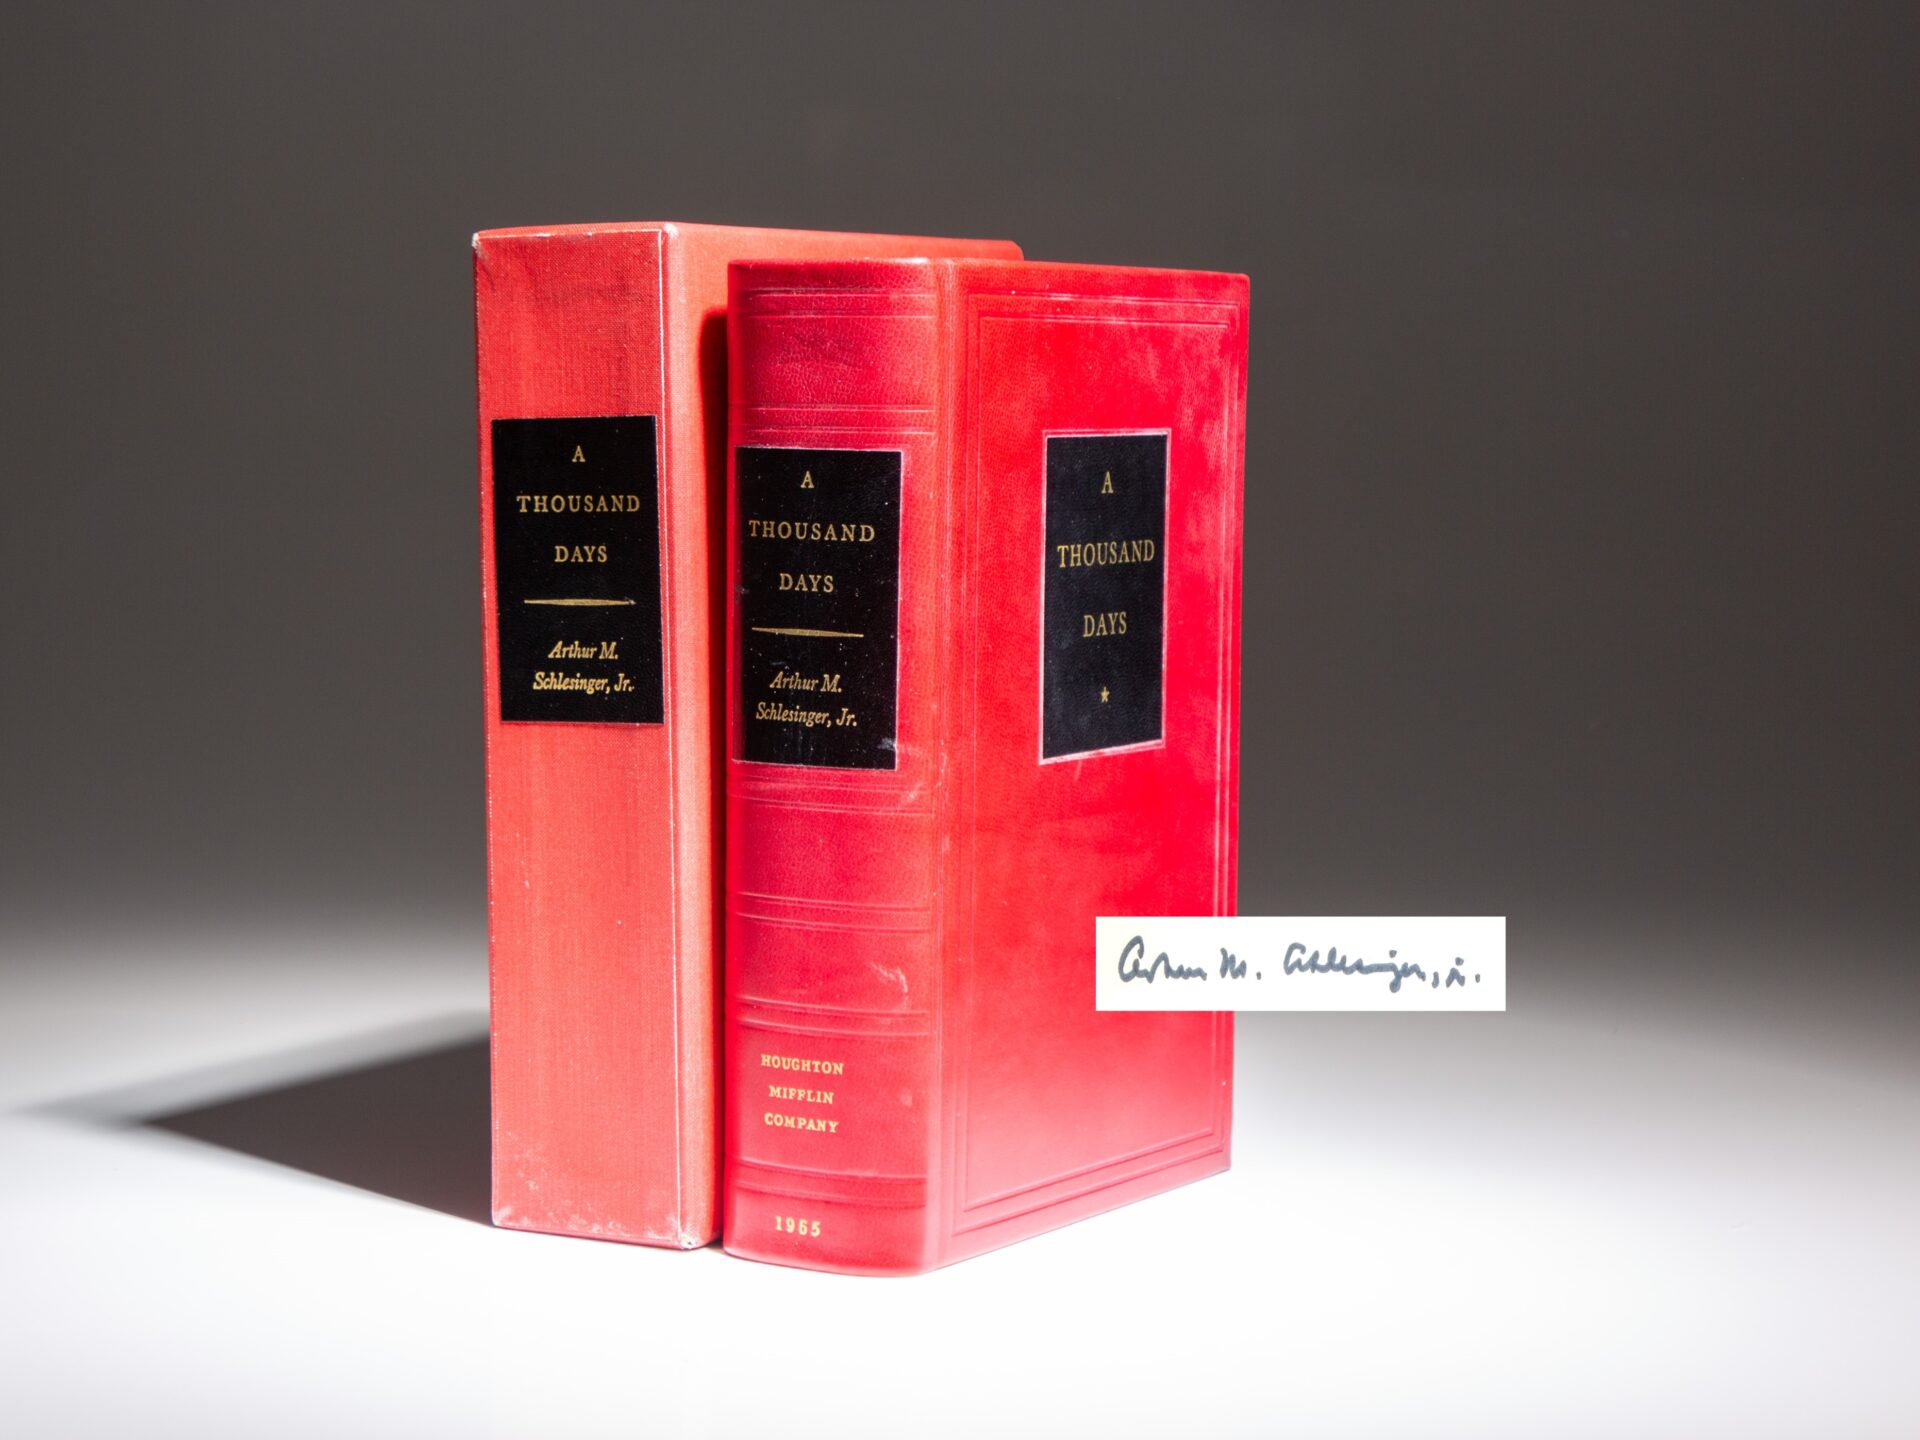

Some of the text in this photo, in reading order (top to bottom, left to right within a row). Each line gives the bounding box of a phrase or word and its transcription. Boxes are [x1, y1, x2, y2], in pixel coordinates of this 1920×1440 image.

[572, 445, 586, 463] A
[800, 470, 815, 489] A
[1101, 470, 1114, 494] A
[516, 495, 641, 513] THOUSAND
[748, 519, 876, 542] THOUSAND
[554, 545, 608, 562] DAYS
[1057, 539, 1155, 568] THOUSAND
[779, 573, 834, 593] DAYS
[1082, 611, 1127, 638] DAYS
[548, 640, 619, 660] Arthur M.
[533, 671, 634, 694] Schlesinger, Jr.
[769, 671, 842, 693] Arthur M.
[756, 702, 857, 728] Schlesinger, Jr.
[761, 1054, 844, 1075] HOUGHTON
[768, 1085, 834, 1105] MIFFLIN
[764, 1112, 839, 1133] COMPANY
[775, 1215, 821, 1237] 1965
